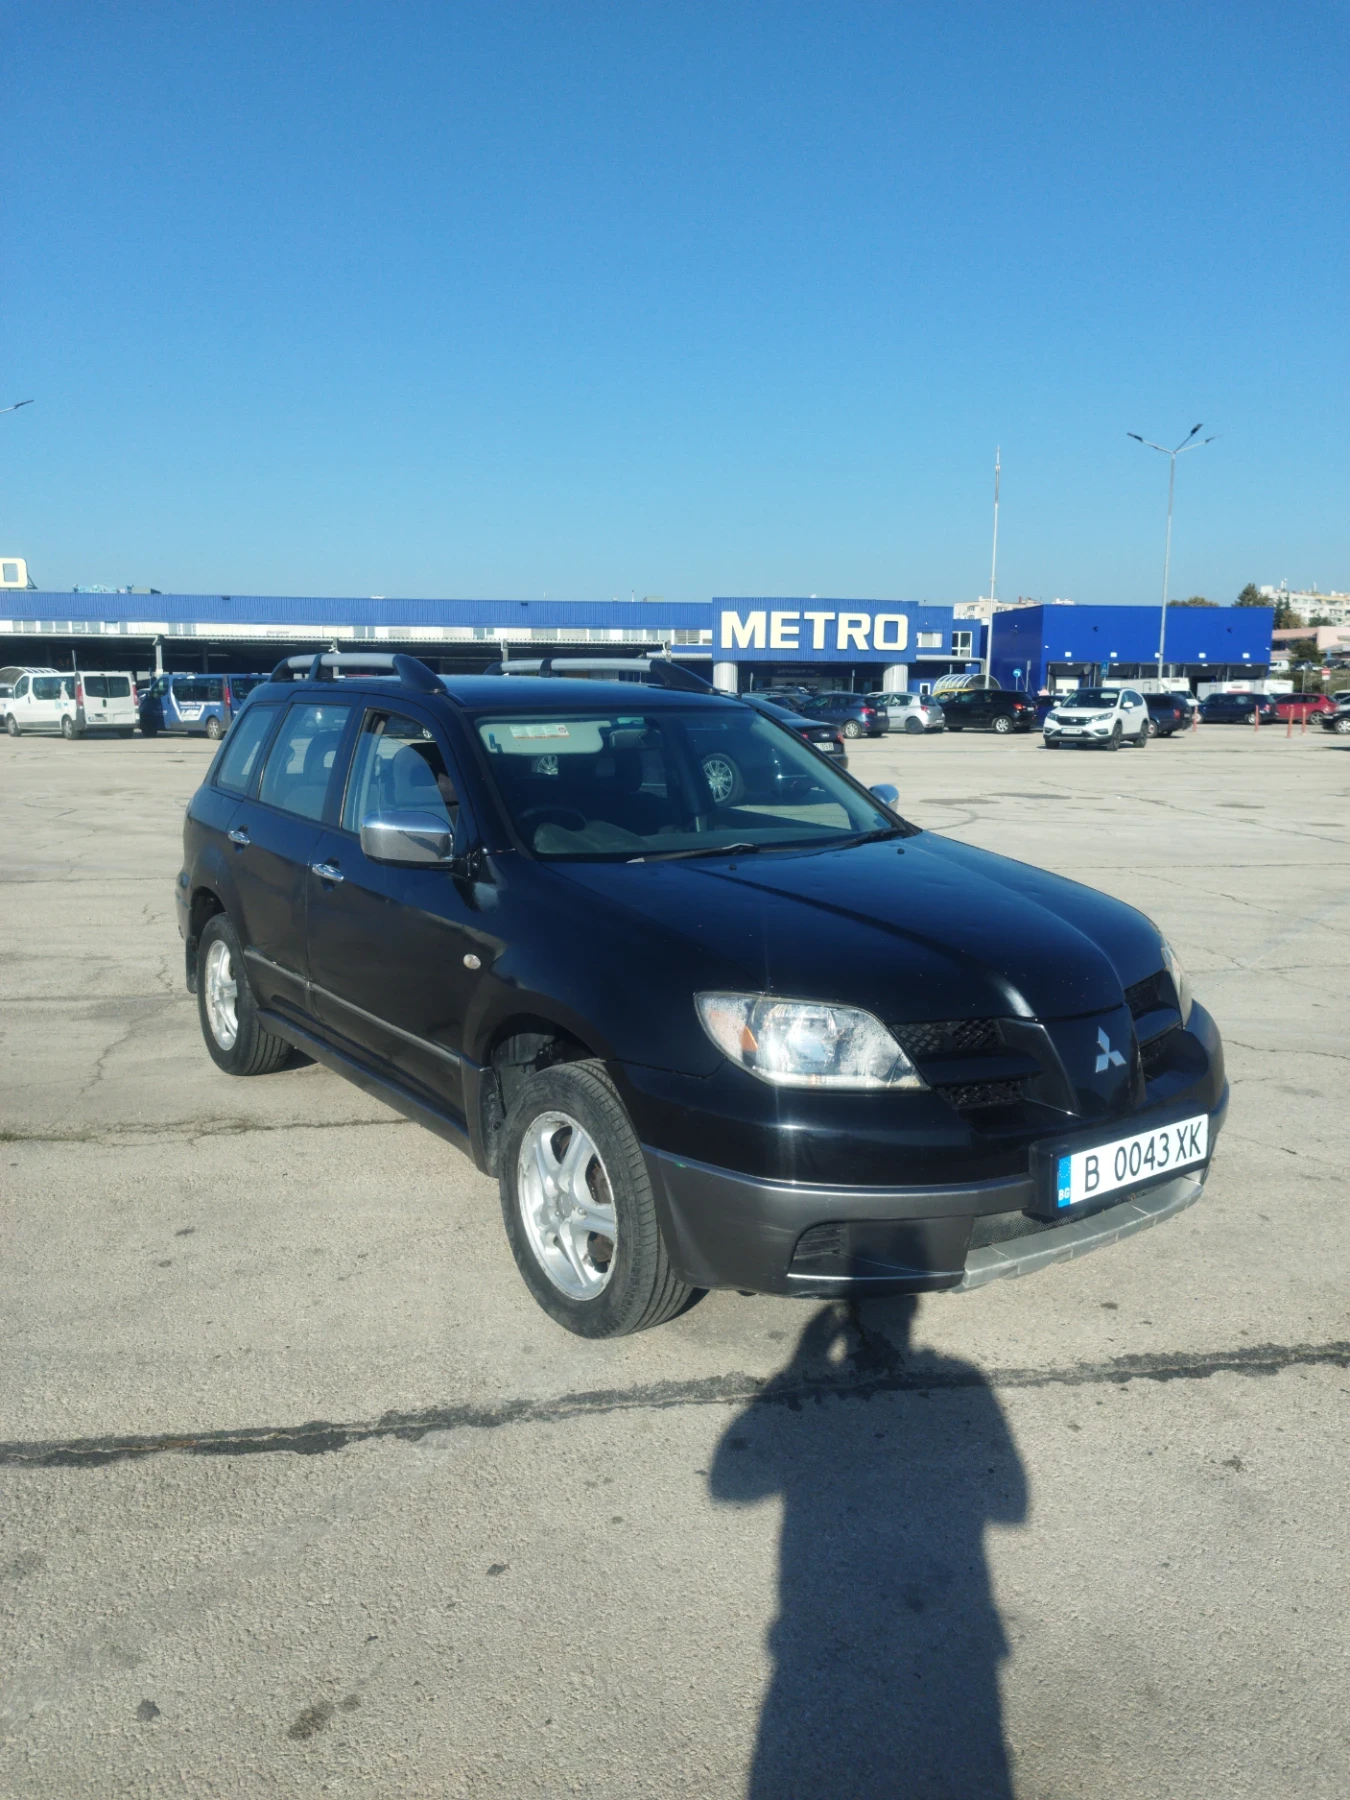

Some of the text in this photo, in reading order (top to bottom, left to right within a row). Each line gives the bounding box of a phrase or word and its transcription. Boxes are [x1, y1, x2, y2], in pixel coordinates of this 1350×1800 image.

[721, 611, 909, 651] METRO
[1084, 1121, 1202, 1192] B 0043 XK
[1058, 1187, 1070, 1201] BG
